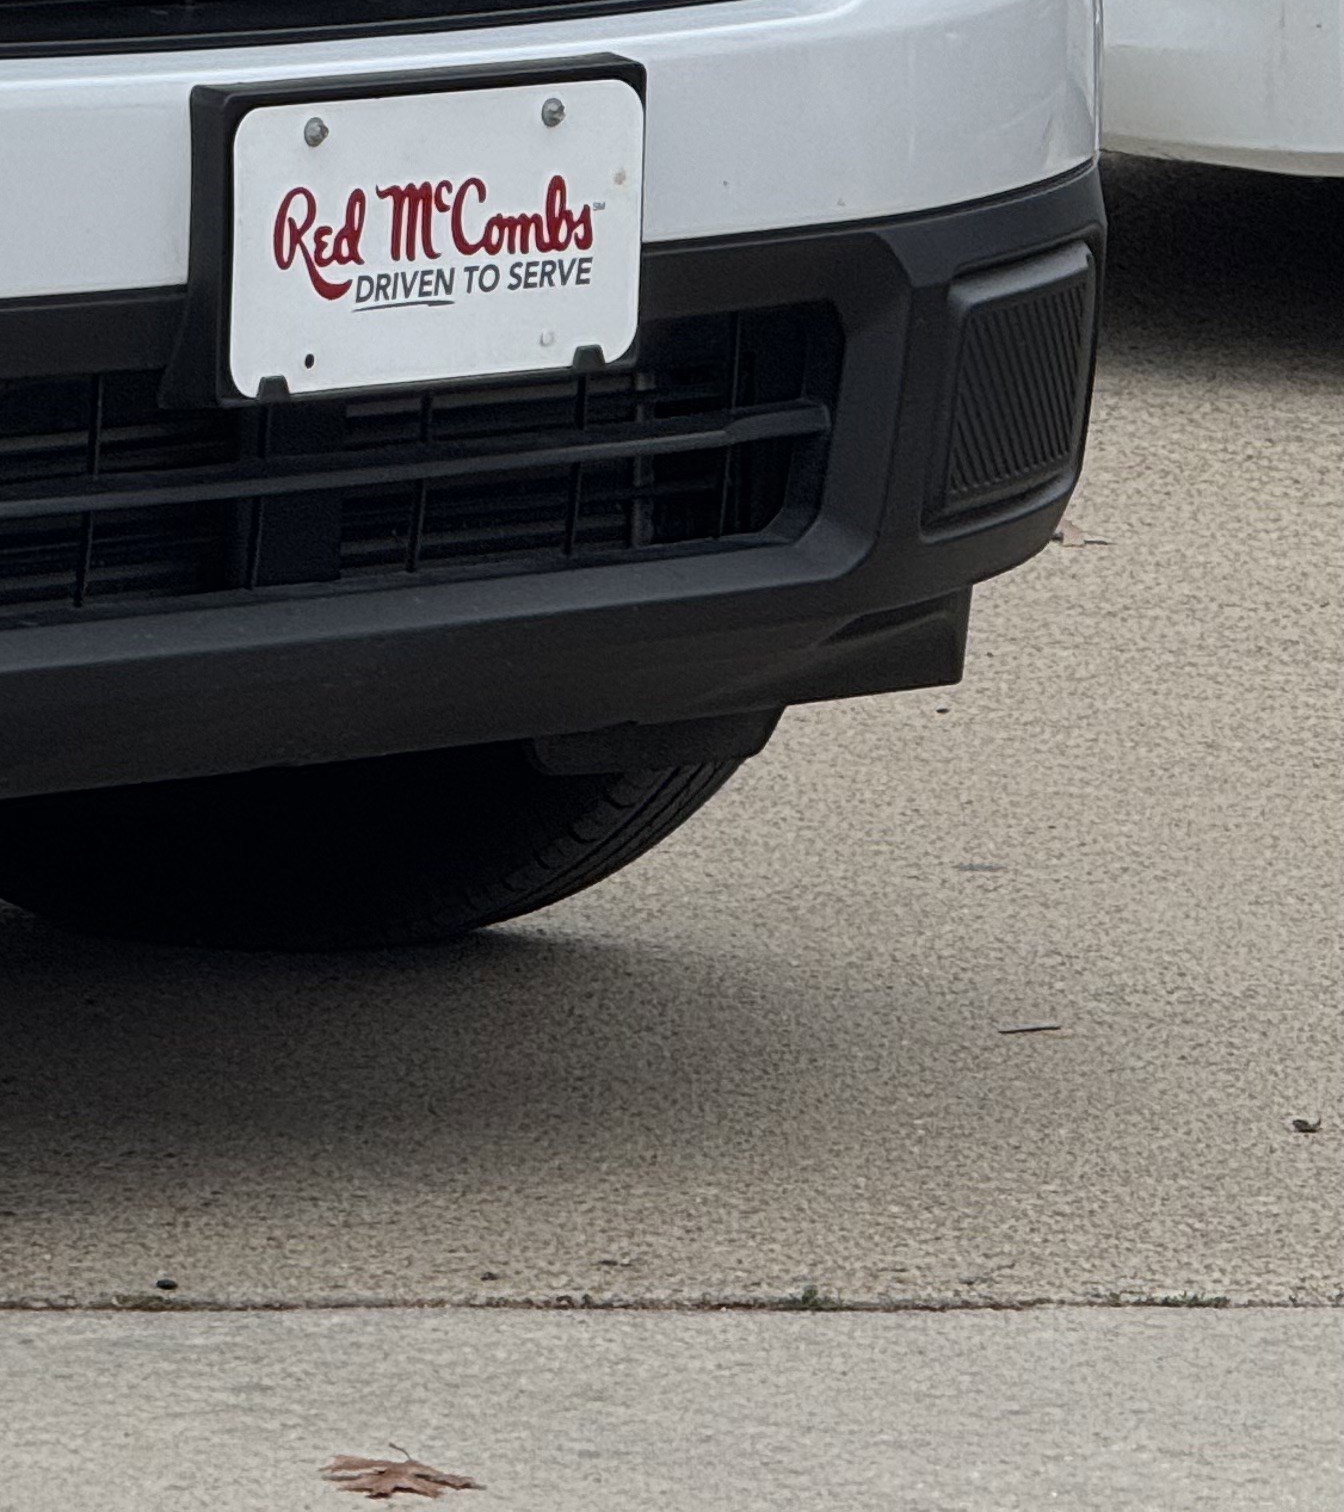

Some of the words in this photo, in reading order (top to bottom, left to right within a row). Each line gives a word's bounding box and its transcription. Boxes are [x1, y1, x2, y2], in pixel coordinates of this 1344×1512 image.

[273, 186, 367, 300] Red
[375, 174, 593, 261] McCombs
[355, 267, 456, 304] DRIVEN
[464, 263, 500, 294] TO
[507, 257, 593, 290] SERVE
